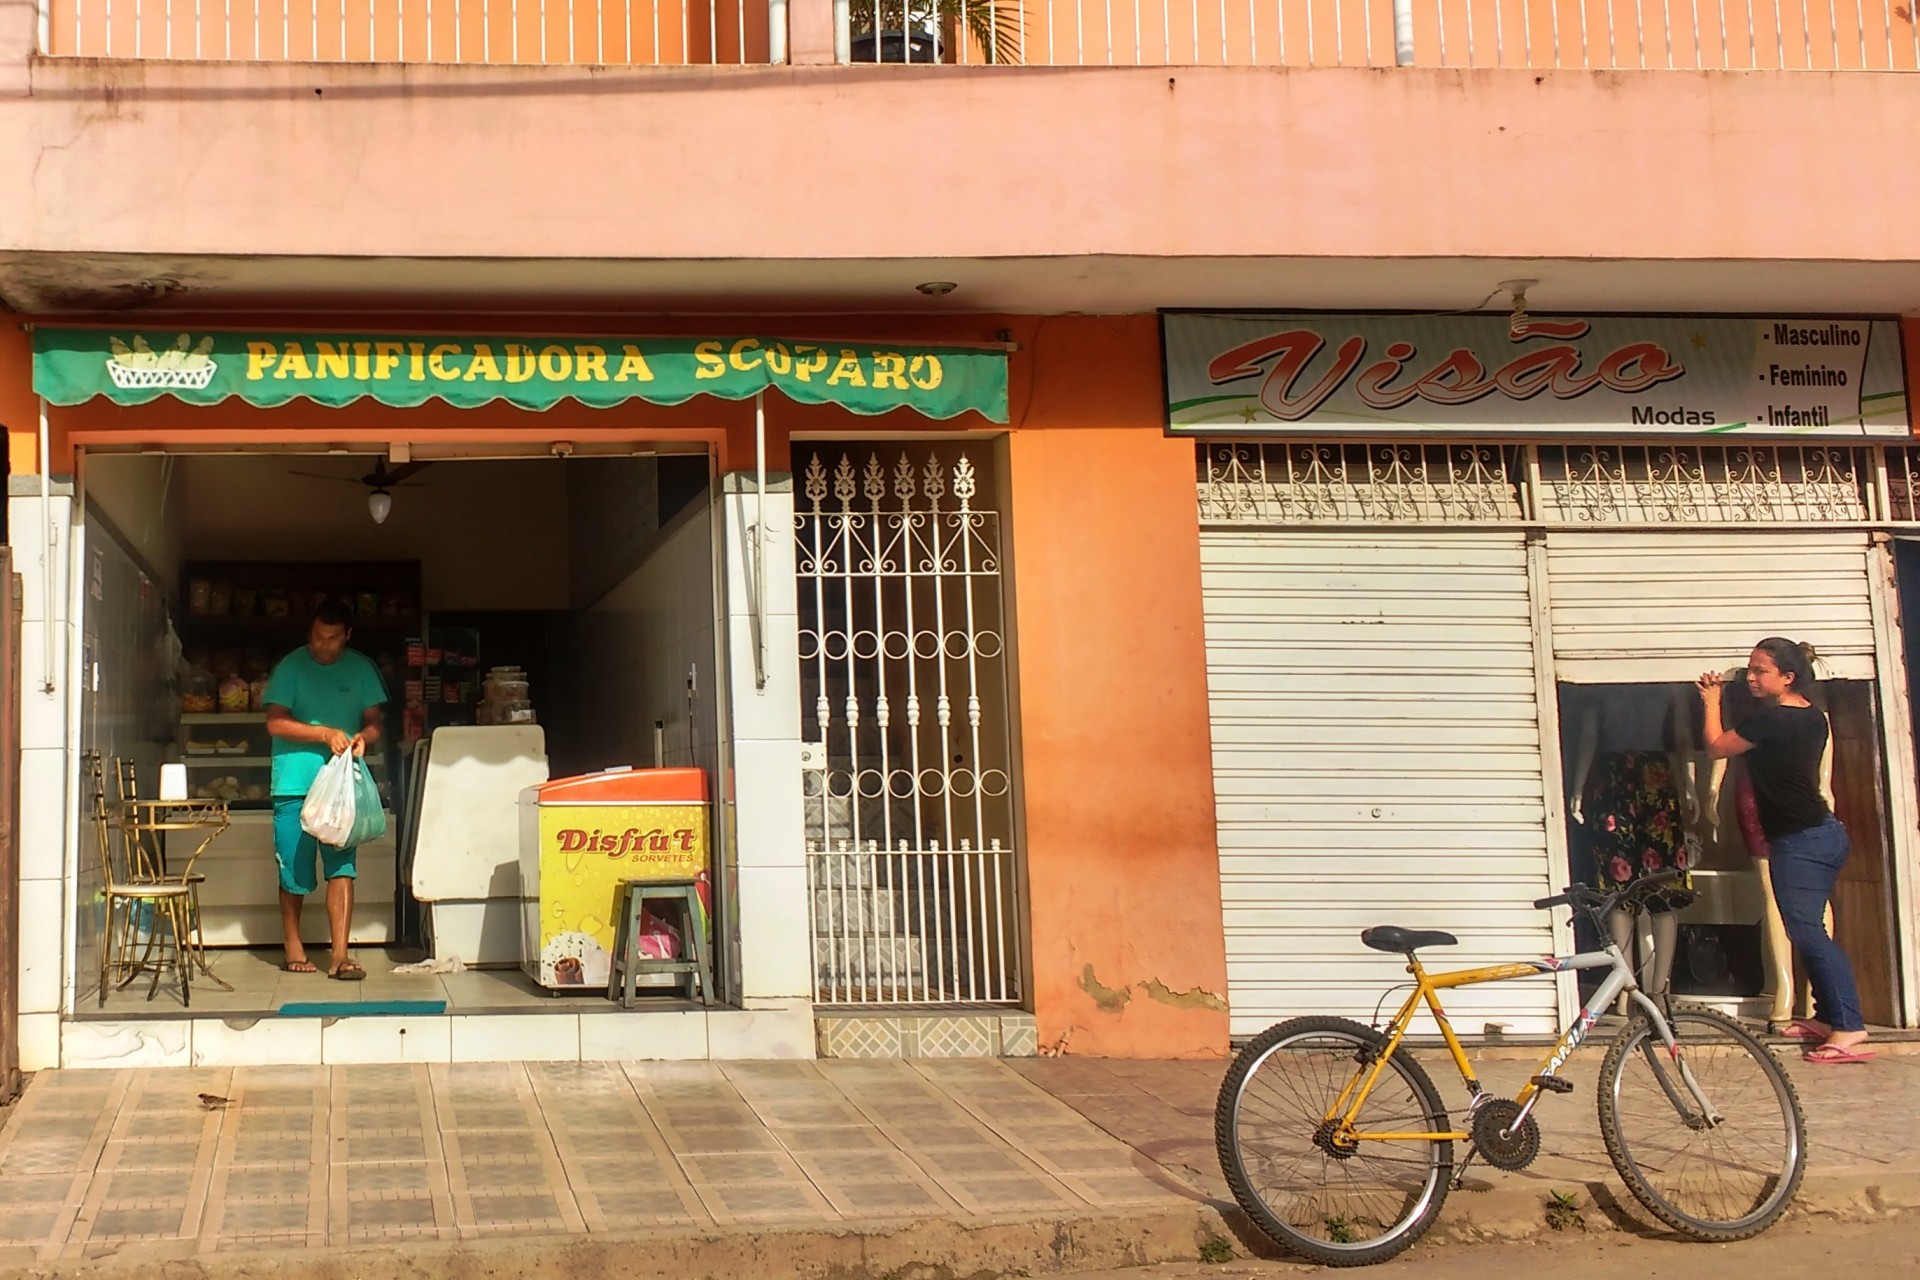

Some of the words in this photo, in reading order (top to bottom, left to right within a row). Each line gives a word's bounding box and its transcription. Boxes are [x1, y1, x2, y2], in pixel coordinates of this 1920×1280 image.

[1773, 323, 1861, 346] Masculino
[245, 341, 655, 383] PANIFICADORA
[694, 338, 943, 391] SCOPARO
[1208, 320, 1686, 421] Visão
[1769, 364, 1848, 387] Feminino
[1631, 406, 1716, 426] Modas
[1767, 405, 1830, 427] Infantil
[556, 828, 696, 859] Disfrut
[631, 854, 694, 863] SORVETES
